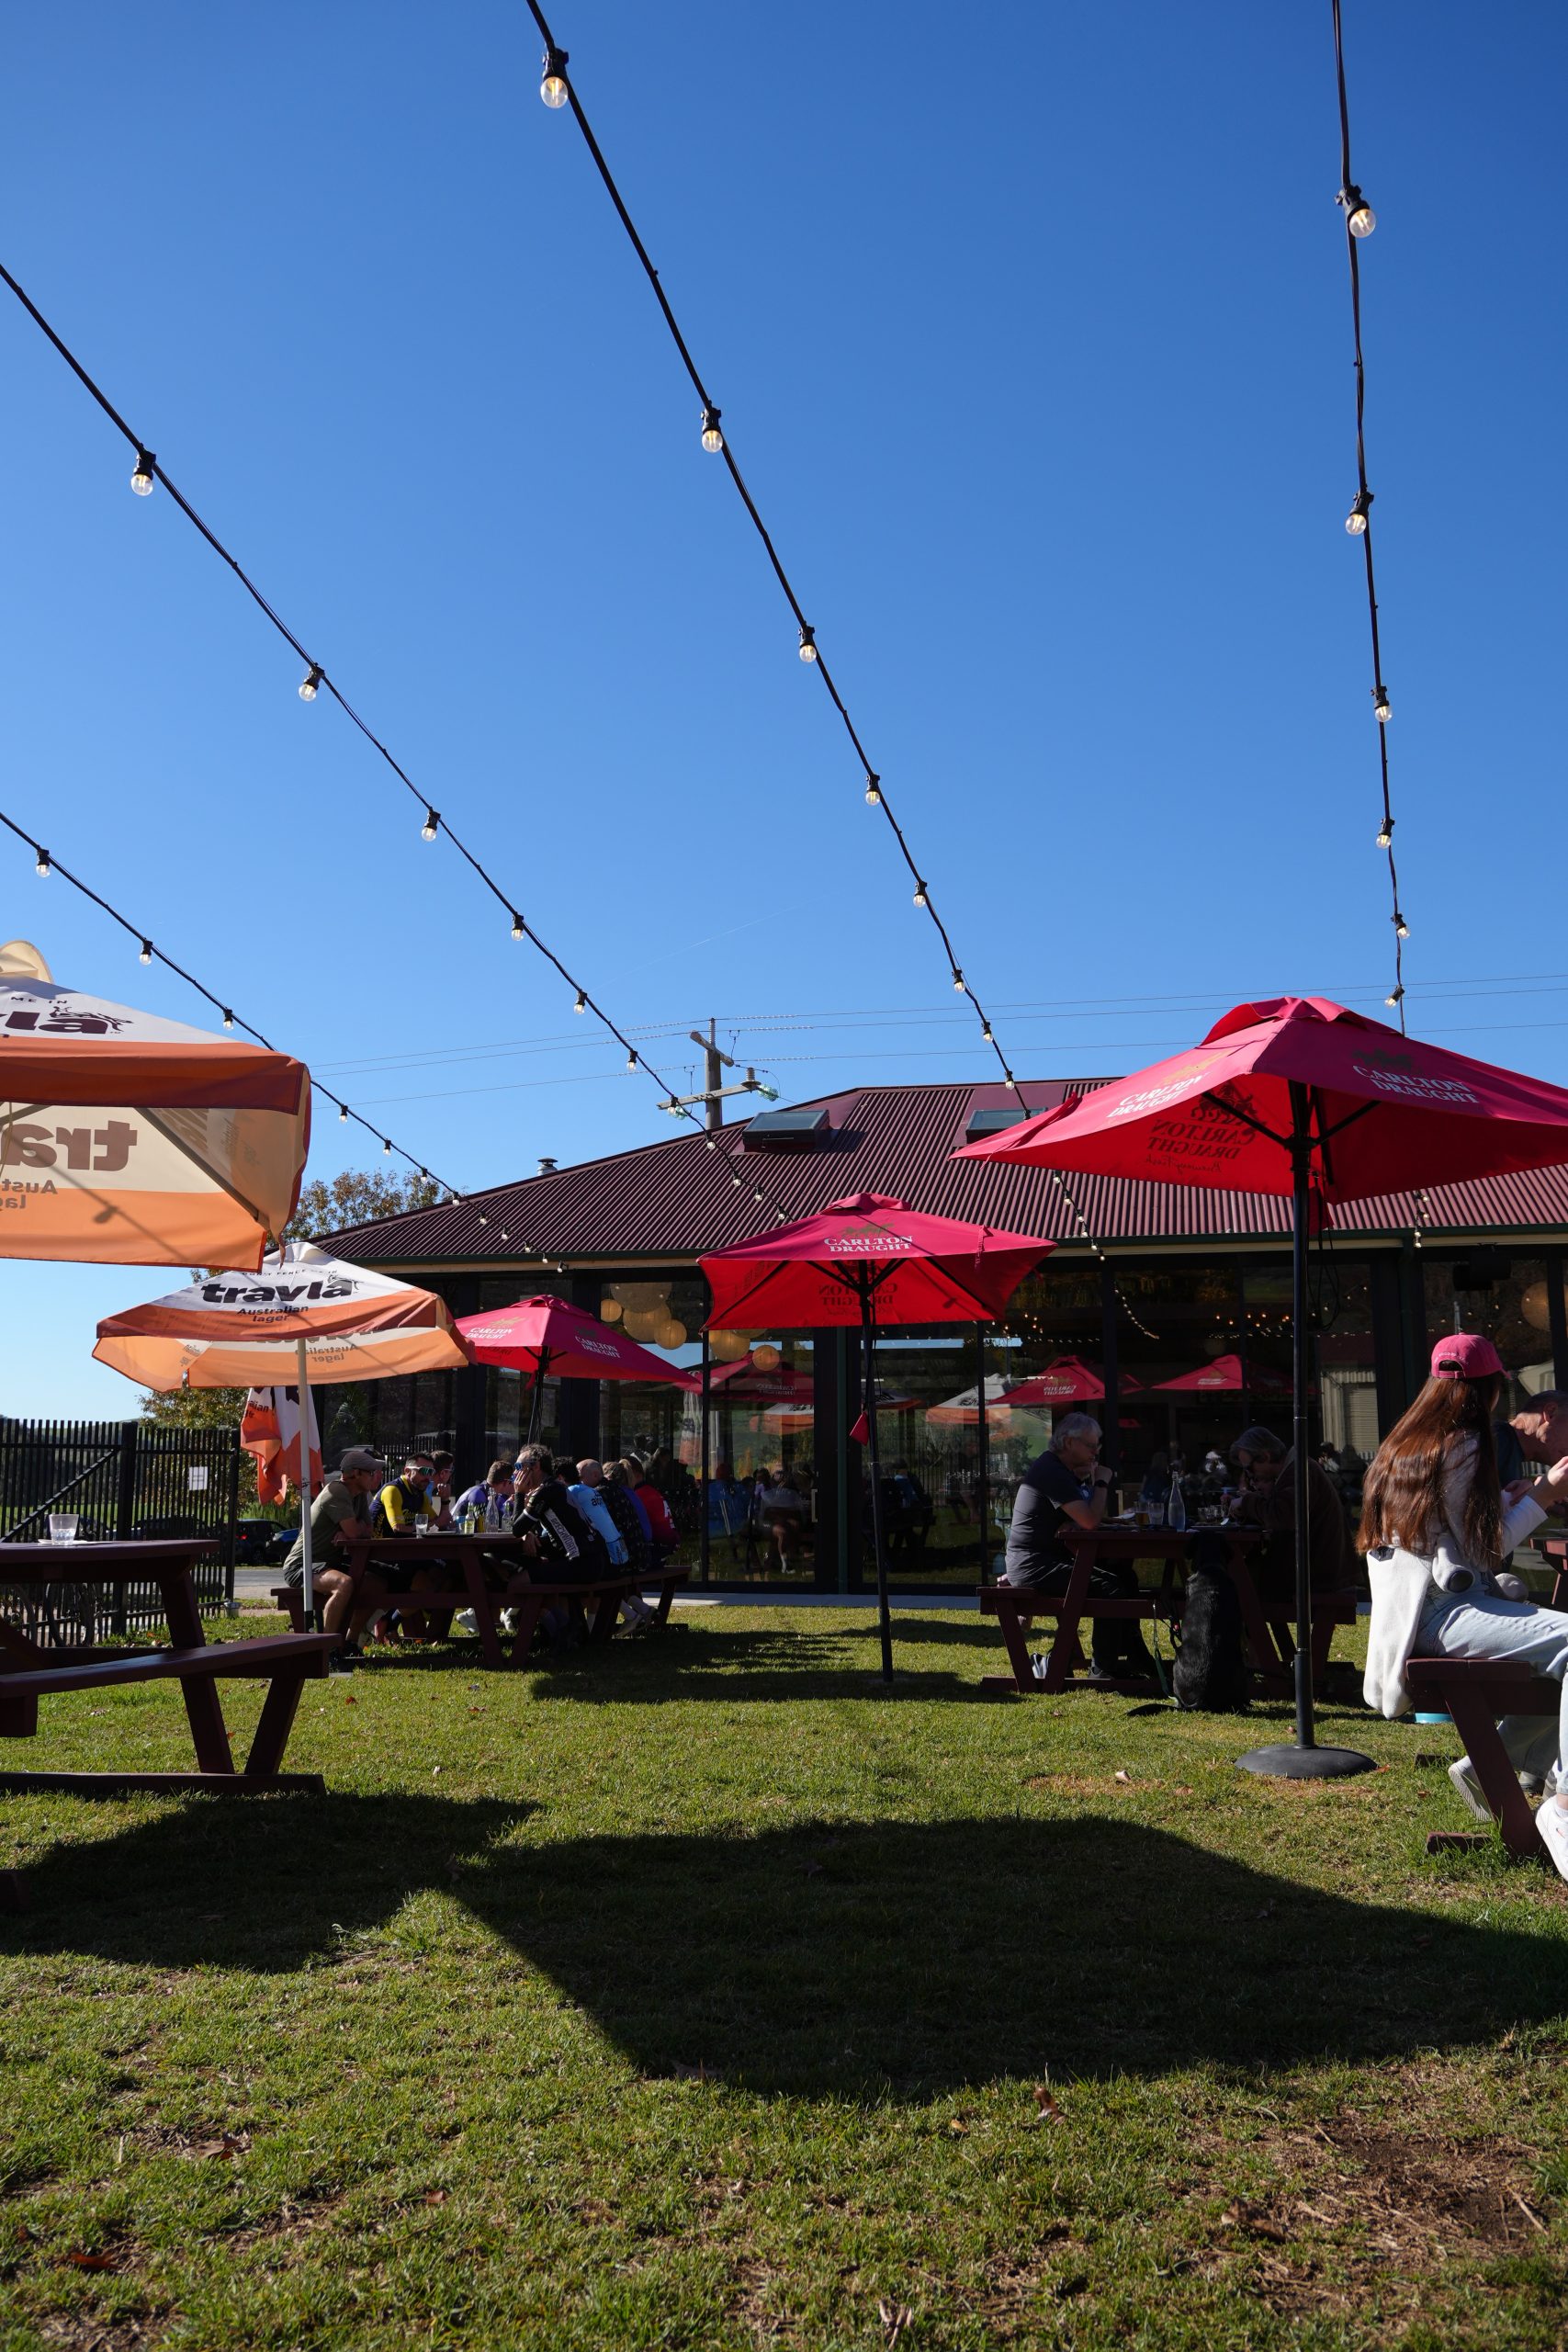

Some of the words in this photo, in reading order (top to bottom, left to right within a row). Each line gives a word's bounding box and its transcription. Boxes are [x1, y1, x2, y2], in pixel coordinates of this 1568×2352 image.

[1119, 1071, 1211, 1105] CARLTON
[1352, 1065, 1472, 1092] CARLTON
[1371, 1079, 1479, 1102] DRAUGHT
[1106, 1087, 1188, 1118] DRAUGHT
[824, 1236, 913, 1246] CARLTON
[829, 1243, 912, 1252] DRAUGHT
[201, 1280, 353, 1303] travla
[237, 1306, 310, 1316] Australian
[252, 1314, 289, 1323] lager
[574, 1335, 618, 1353] CARLTON
